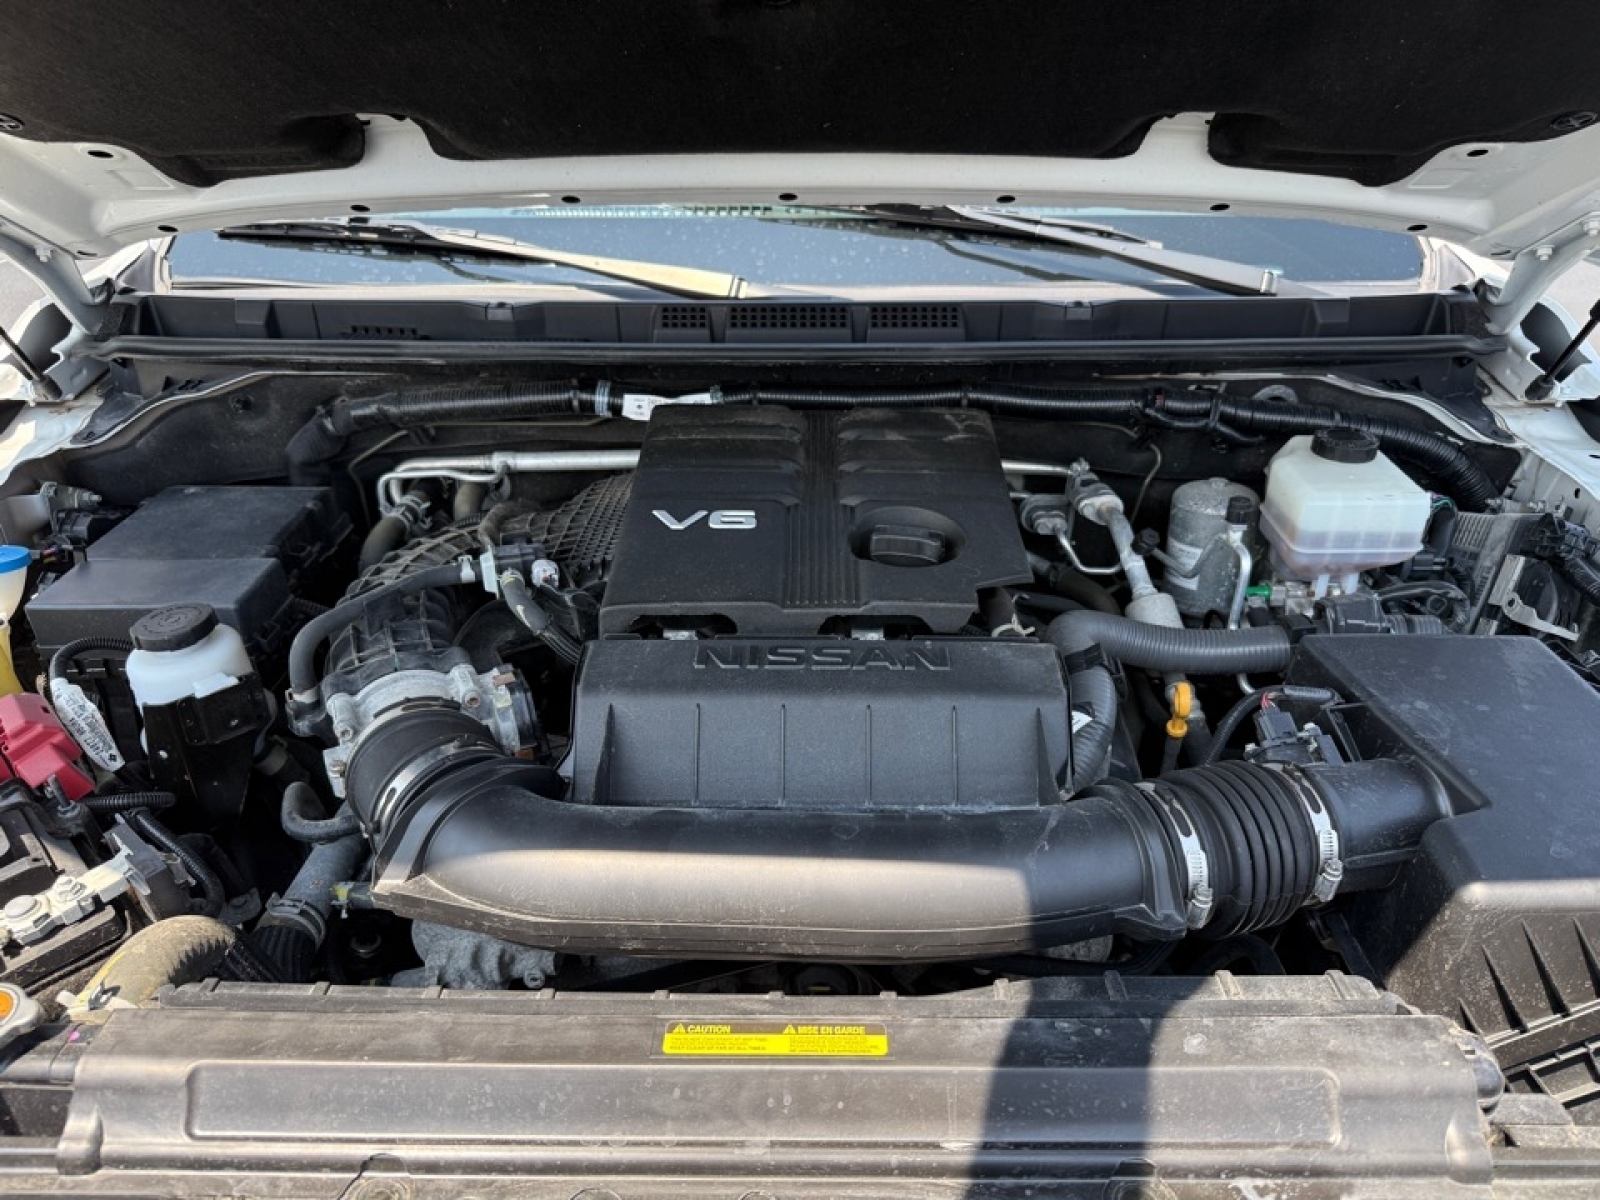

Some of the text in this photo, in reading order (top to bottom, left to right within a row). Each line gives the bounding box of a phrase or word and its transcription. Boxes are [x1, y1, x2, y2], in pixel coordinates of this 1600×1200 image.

[651, 509, 757, 530] V6
[693, 644, 951, 670] NISSAN
[687, 1025, 731, 1034] CAUTION
[797, 1026, 866, 1035] MISE EN GARDE
